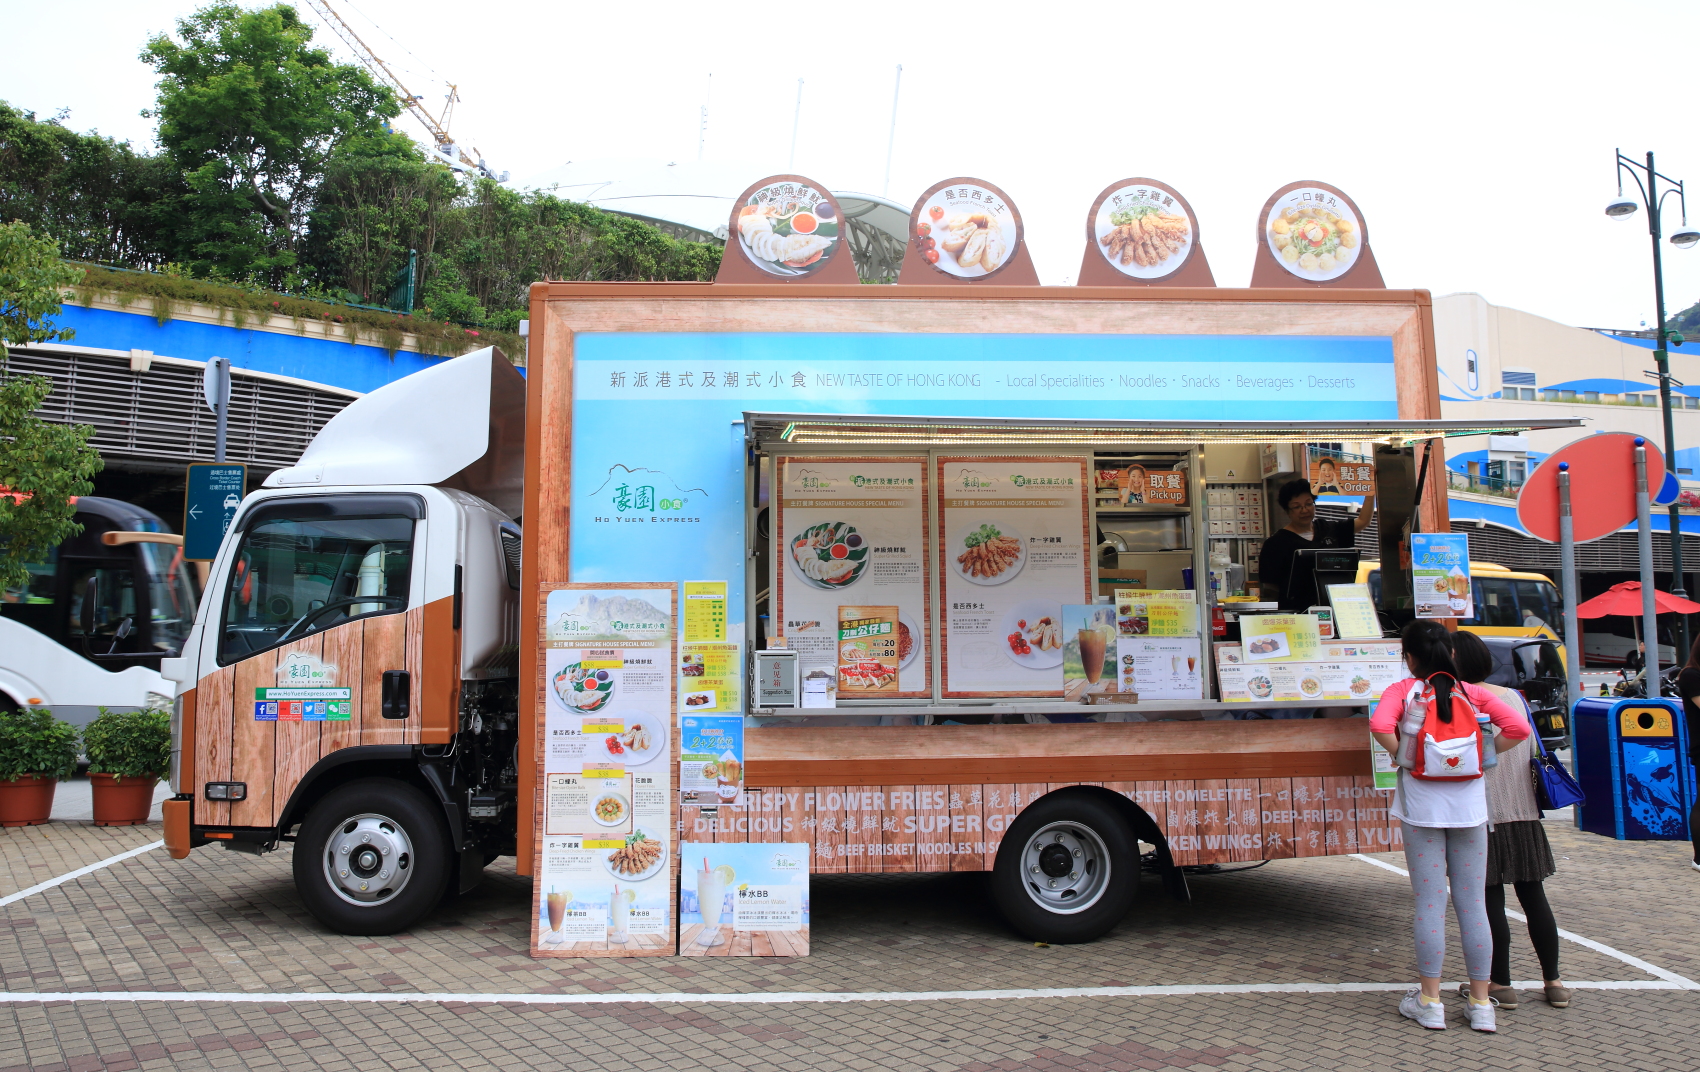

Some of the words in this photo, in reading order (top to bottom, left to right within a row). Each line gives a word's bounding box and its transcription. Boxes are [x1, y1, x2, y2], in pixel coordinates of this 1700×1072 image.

[757, 184, 822, 204] 神級燒鮮魷
[945, 188, 1005, 214] 是否西多士
[1112, 189, 1174, 208] 炸一字雞翼
[1290, 192, 1337, 208] 一口蠔丸
[610, 370, 806, 388] 新派港式及潮式小食
[816, 373, 846, 387] NEW
[847, 373, 883, 387] TASTE
[886, 373, 903, 387] OF
[907, 373, 945, 387] HONG
[948, 373, 981, 387] KONG
[1007, 374, 1037, 388] Local
[1041, 374, 1105, 390] Specialities
[1119, 374, 1167, 388] Noodles
[1181, 375, 1220, 388] Snacks
[1236, 375, 1294, 391] Beverages
[1308, 375, 1356, 388] Desserts
[1150, 474, 1180, 489] 取餐
[1340, 466, 1371, 481] 點餐
[1150, 490, 1169, 499] Pick
[1170, 491, 1182, 501] up
[1344, 482, 1372, 491] Order
[613, 482, 655, 512] 豪園
[804, 792, 885, 811] FLOWER
[890, 791, 944, 810] FRIES
[1175, 788, 1252, 801] OMELETTE
[1257, 786, 1331, 804] 一口蠔丸
[694, 817, 794, 833] DELICIOUS
[801, 815, 900, 834] 神級燒鮮魷
[904, 815, 981, 833] SUPER
[1262, 809, 1344, 823] DEEP-FRIED
[837, 844, 866, 856] BEEF
[868, 843, 915, 856] BRISKET
[917, 842, 971, 855] NOODLES
[974, 842, 986, 853] IN
[1205, 834, 1262, 850] WINGS
[1267, 829, 1358, 849] 炸一字雞翼
[739, 889, 769, 898] 檸水BB
